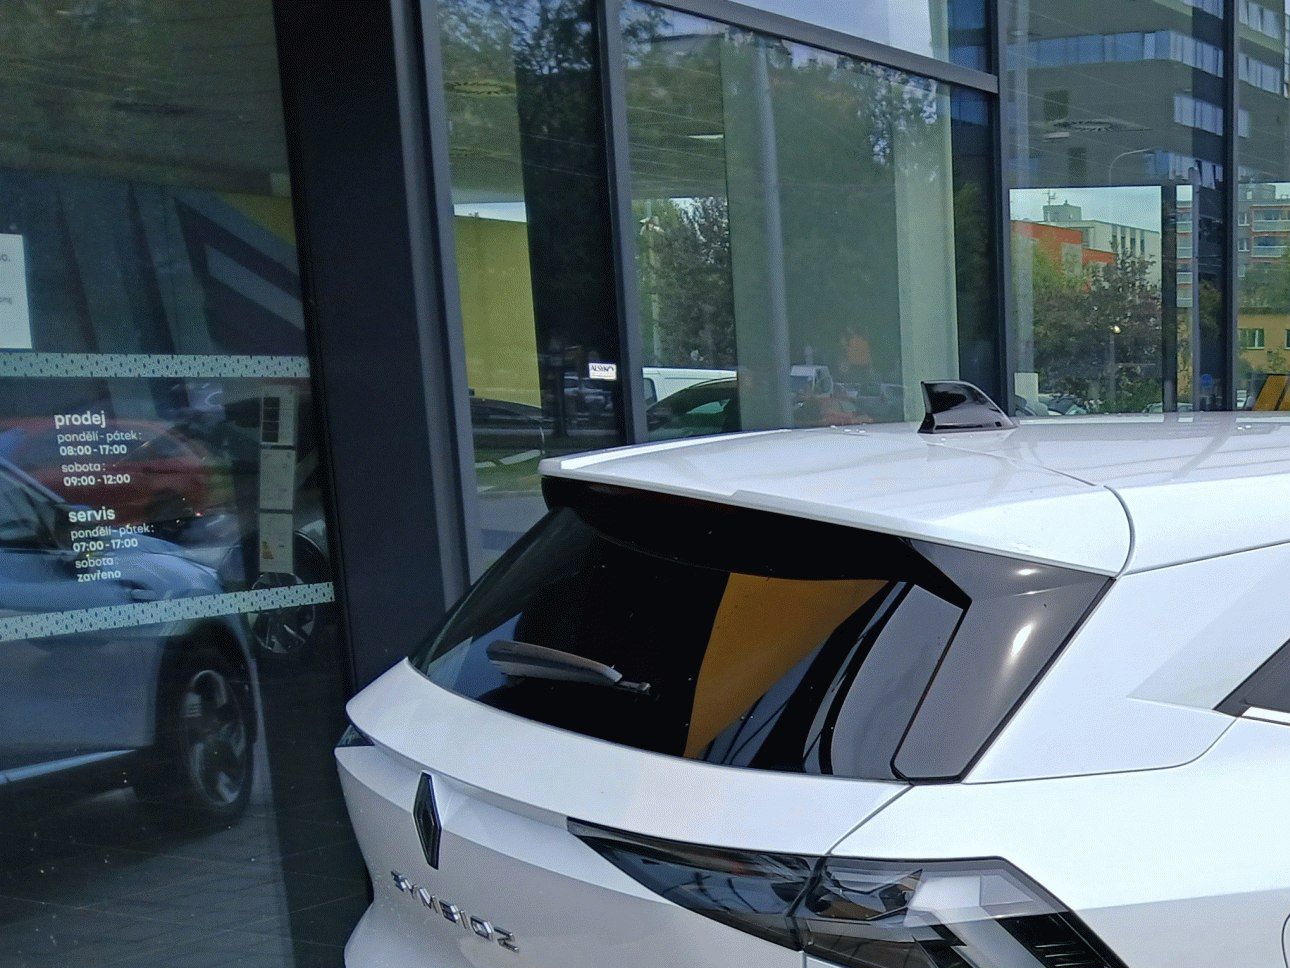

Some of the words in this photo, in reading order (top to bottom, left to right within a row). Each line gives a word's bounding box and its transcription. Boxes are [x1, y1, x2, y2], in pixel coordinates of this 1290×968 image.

[54, 410, 106, 429] prodej
[68, 506, 116, 523] servis
[76, 568, 121, 582] zavřeno
